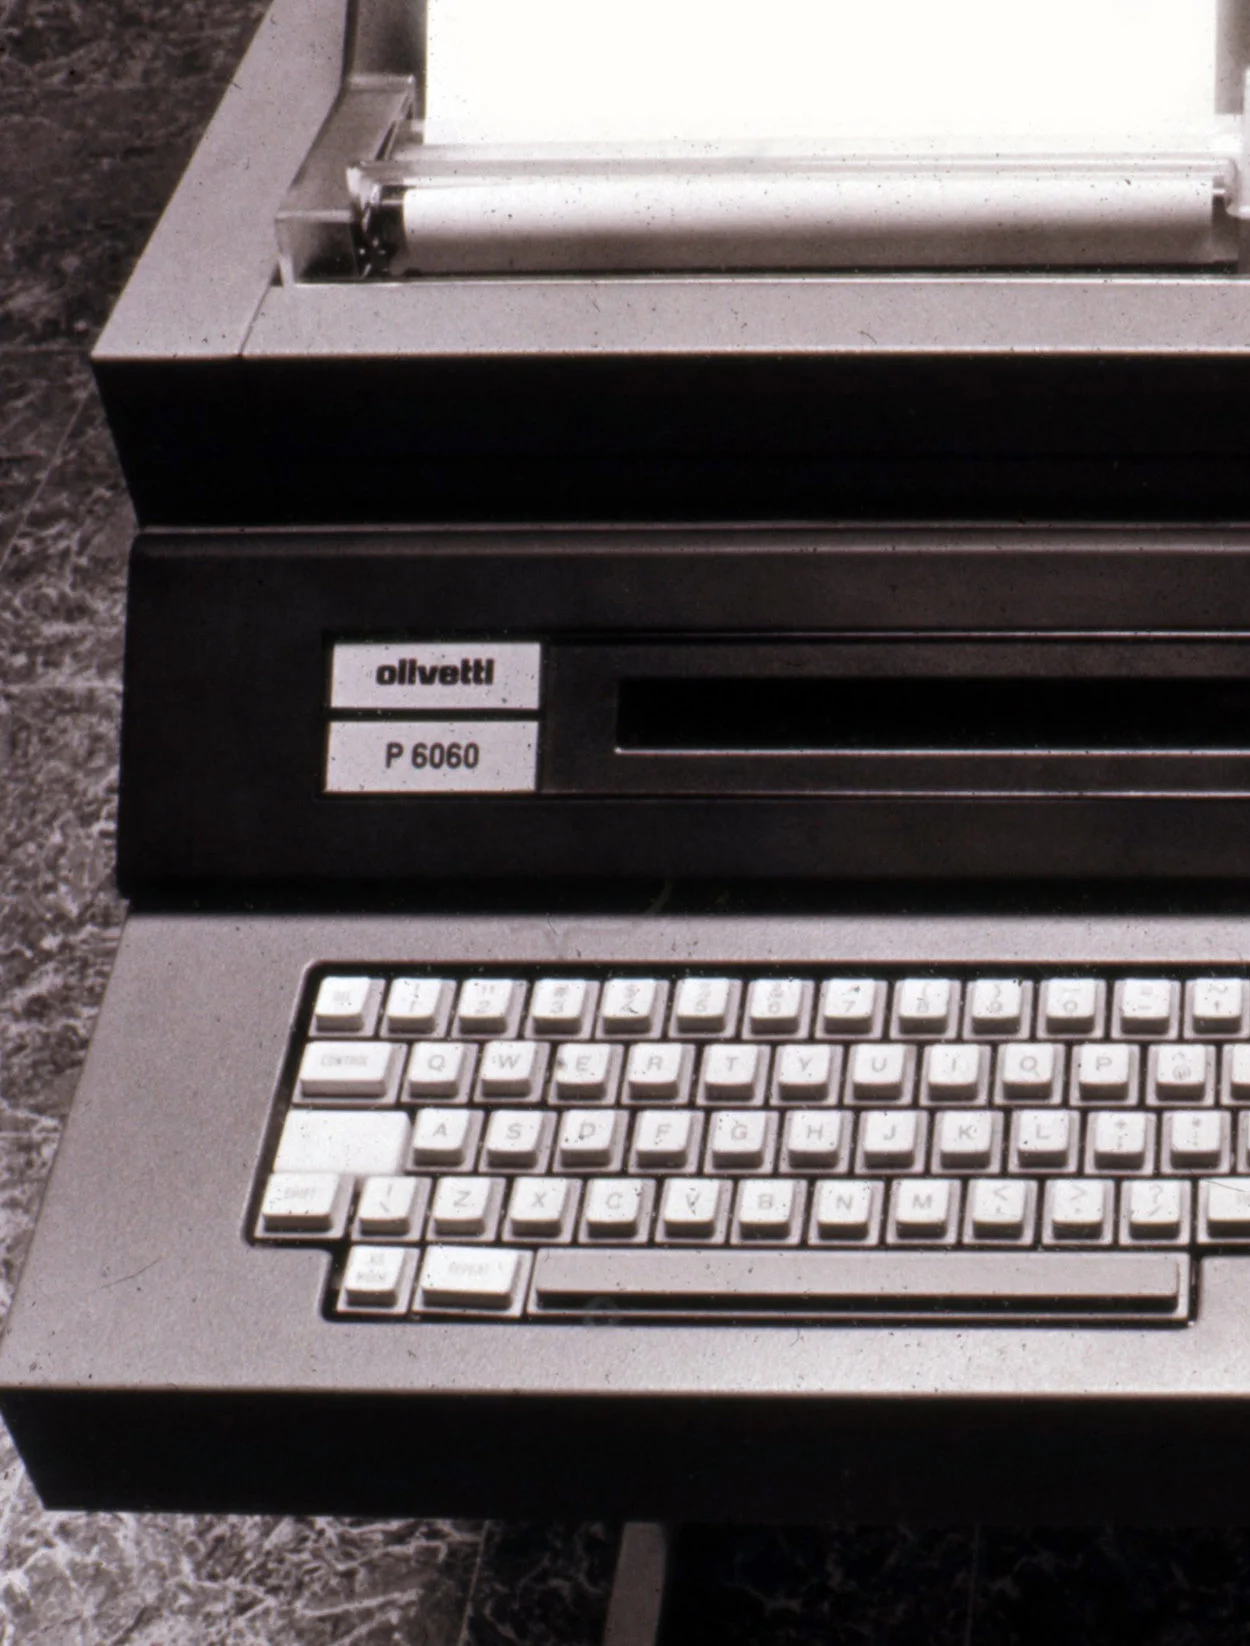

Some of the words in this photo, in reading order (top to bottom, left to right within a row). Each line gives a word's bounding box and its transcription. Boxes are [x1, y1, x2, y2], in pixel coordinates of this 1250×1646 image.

[386, 742, 404, 768] P
[411, 742, 480, 769] 6060
[427, 1054, 446, 1072] Q
[499, 1054, 521, 1069] W
[574, 1055, 592, 1072] E
[646, 1055, 664, 1071] R
[725, 1056, 738, 1072] T
[797, 1056, 813, 1073] Y
[870, 1056, 887, 1073] U
[1095, 1055, 1113, 1072] P
[432, 1121, 448, 1138] A
[506, 1122, 523, 1140] S
[577, 1121, 596, 1140] D
[654, 1122, 671, 1141] F
[730, 1122, 749, 1142] G
[806, 1123, 824, 1142] H
[884, 1122, 897, 1142] J
[957, 1123, 974, 1141] K
[1035, 1123, 1051, 1140] L
[453, 1190, 471, 1208] Z
[529, 1191, 547, 1208] X
[605, 1192, 624, 1210] C
[758, 1192, 773, 1210] B
[835, 1194, 852, 1211] N
[912, 1193, 932, 1210] M
